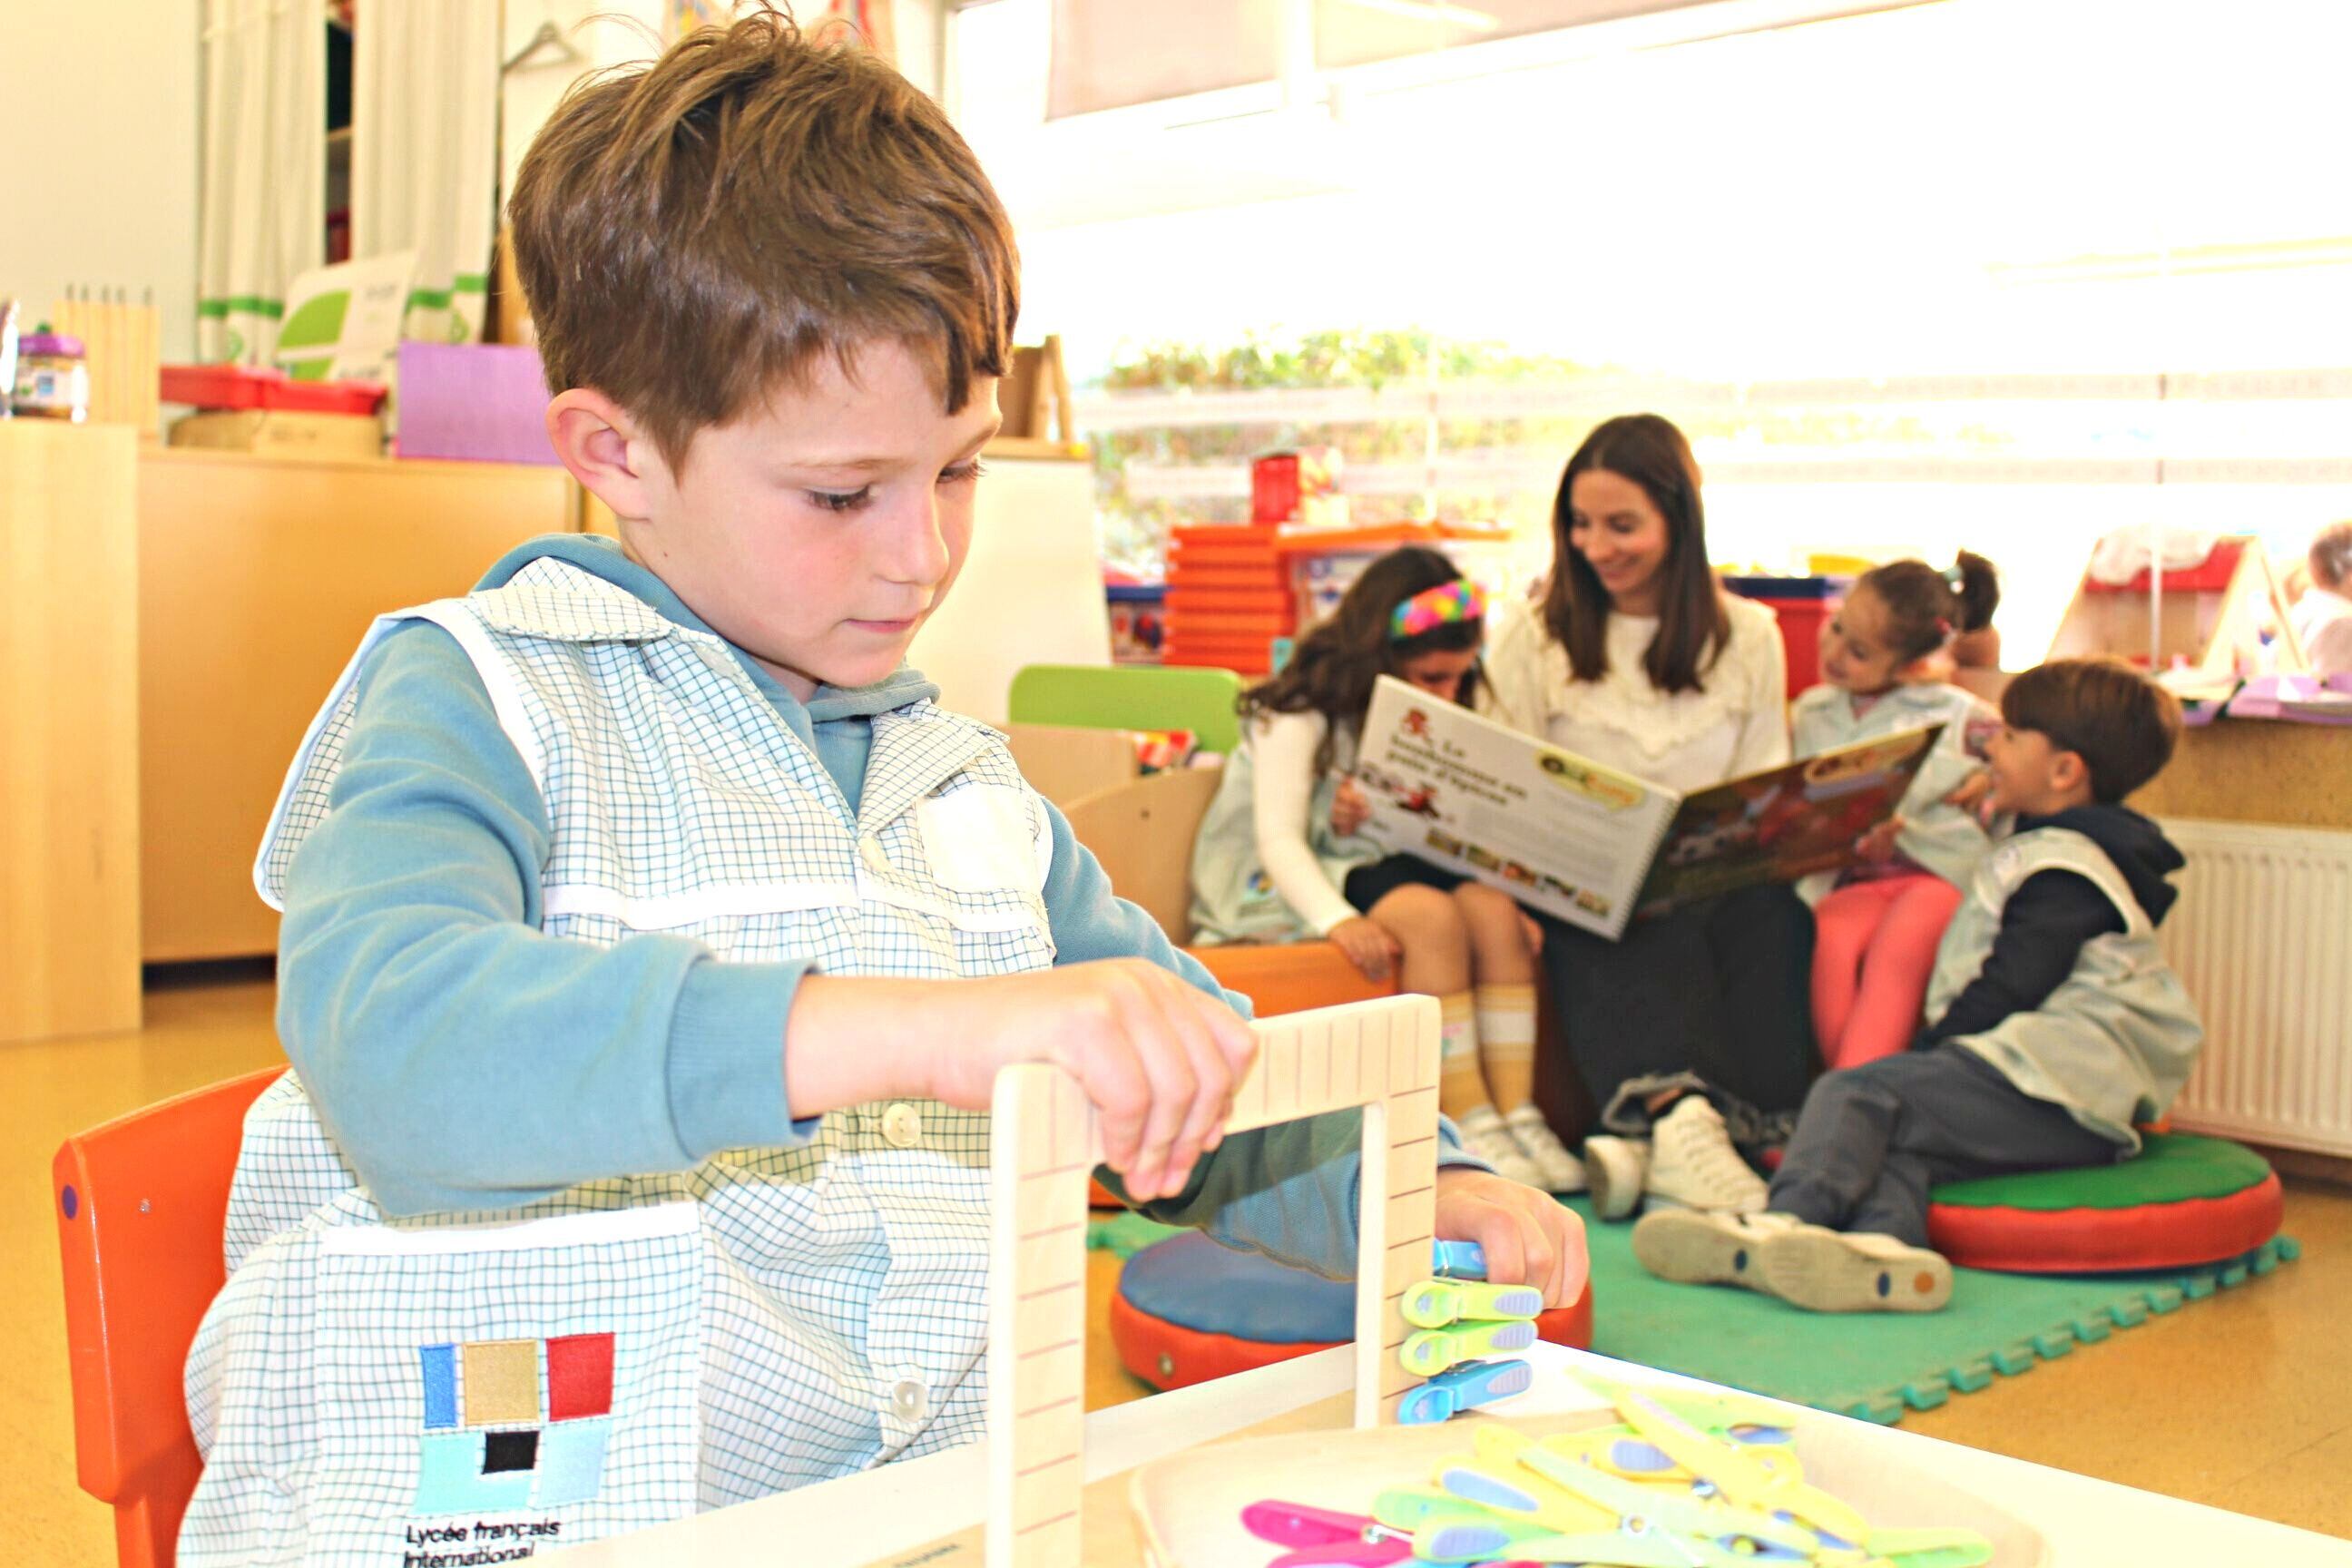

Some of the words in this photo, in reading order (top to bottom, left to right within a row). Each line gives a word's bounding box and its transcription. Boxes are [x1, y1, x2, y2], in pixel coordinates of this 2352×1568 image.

[407, 1521, 468, 1548] Lycée
[475, 1517, 562, 1541] français
[404, 1541, 535, 1568] International
